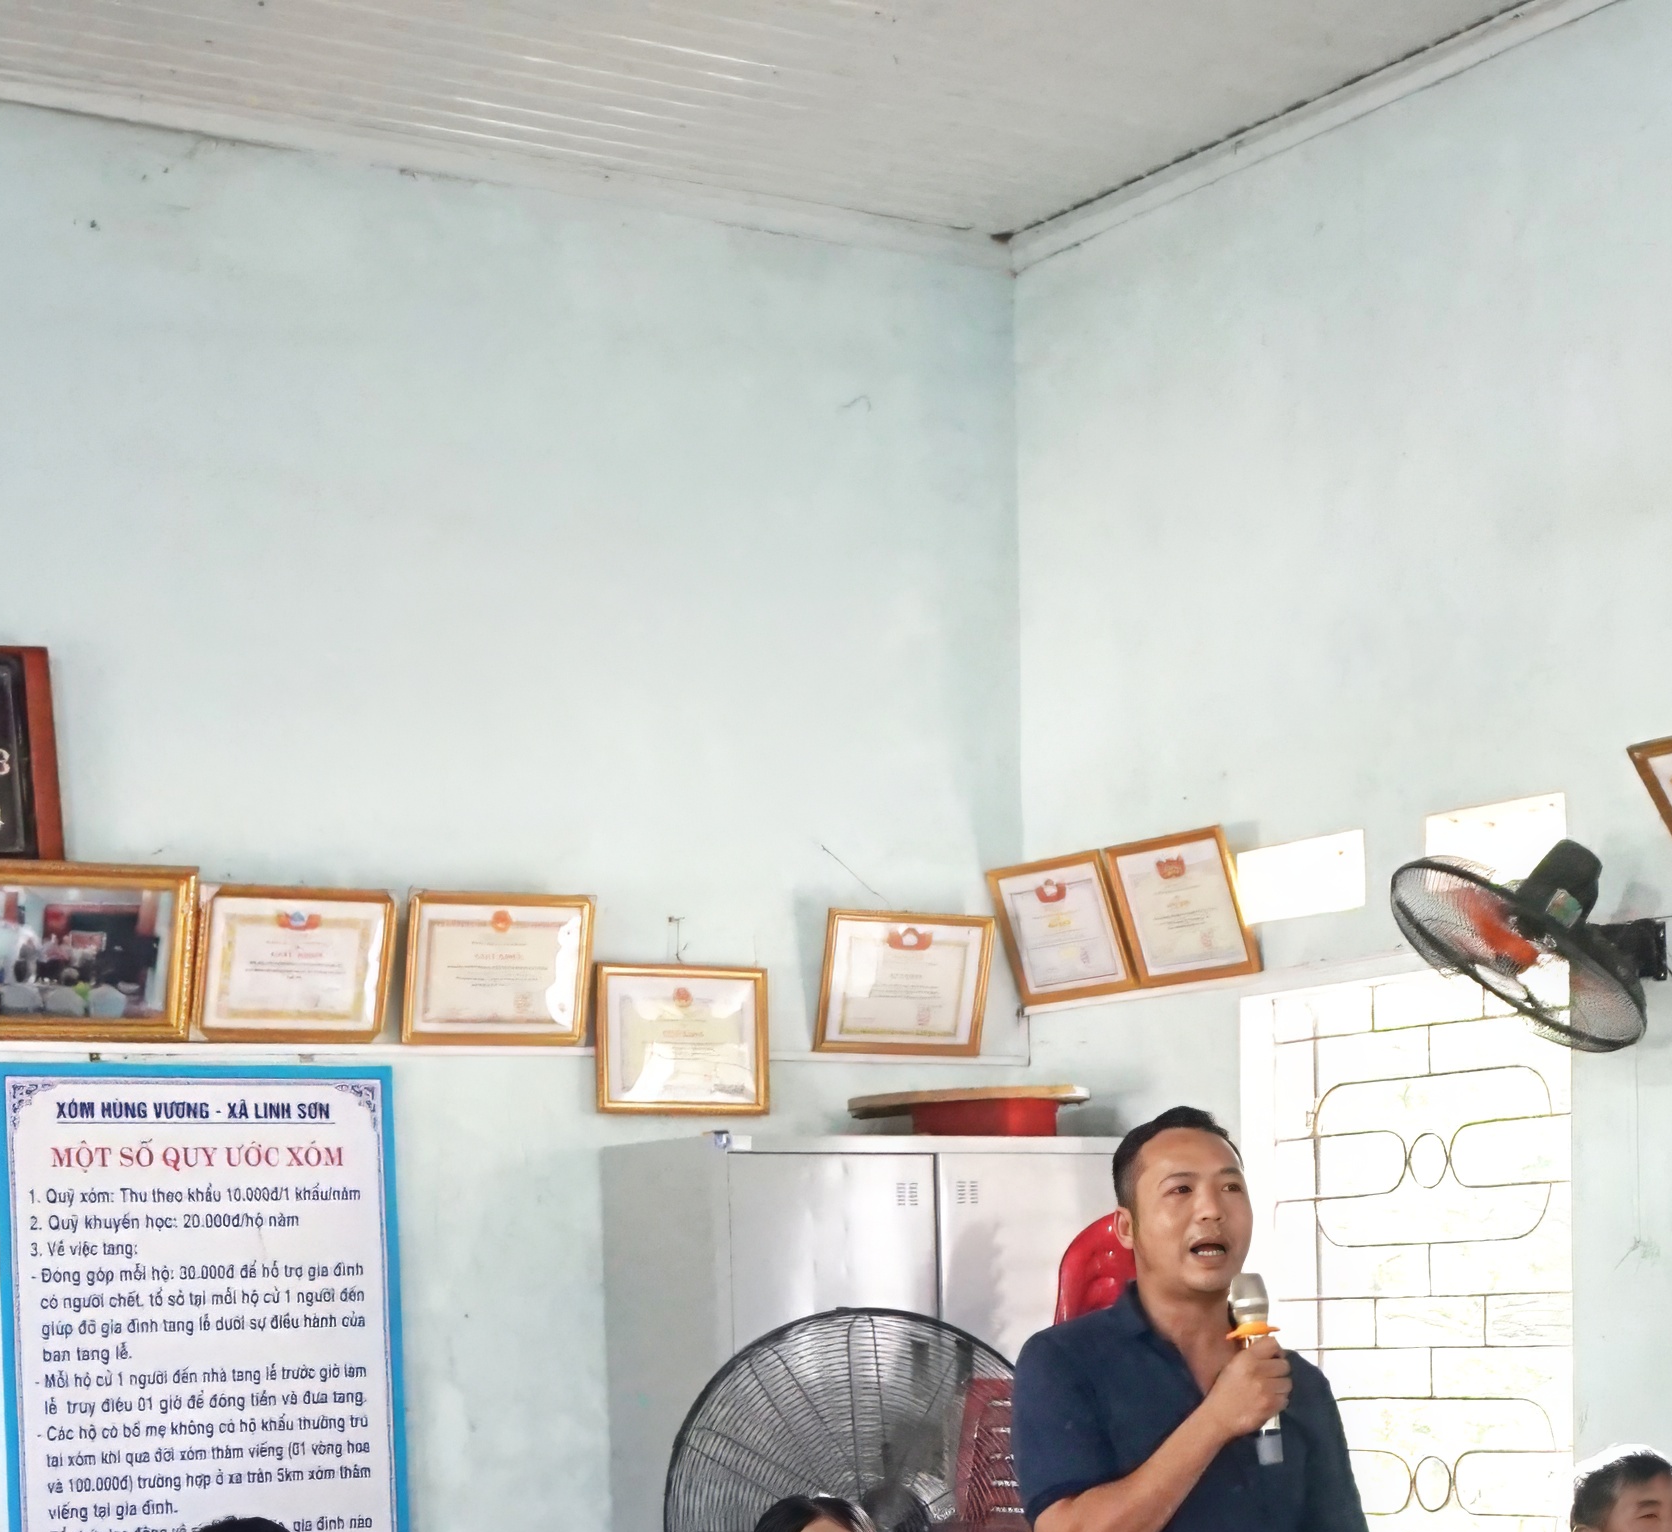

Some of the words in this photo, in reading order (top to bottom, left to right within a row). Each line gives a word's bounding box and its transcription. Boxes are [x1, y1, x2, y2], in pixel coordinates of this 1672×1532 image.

[57, 1100, 95, 1119] XÓM
[101, 1102, 147, 1119] HÙNG
[153, 1101, 209, 1119] VƯƠNG
[227, 1100, 249, 1119] XÃ
[254, 1102, 291, 1119] LINH
[297, 1102, 330, 1119] SƠN
[50, 1140, 111, 1172] MỘT
[120, 1139, 154, 1167] SỐ
[162, 1147, 217, 1171] QUY
[227, 1141, 279, 1167] ƯỚC
[286, 1141, 344, 1167] XÓM
[29, 1189, 40, 1204] 1.
